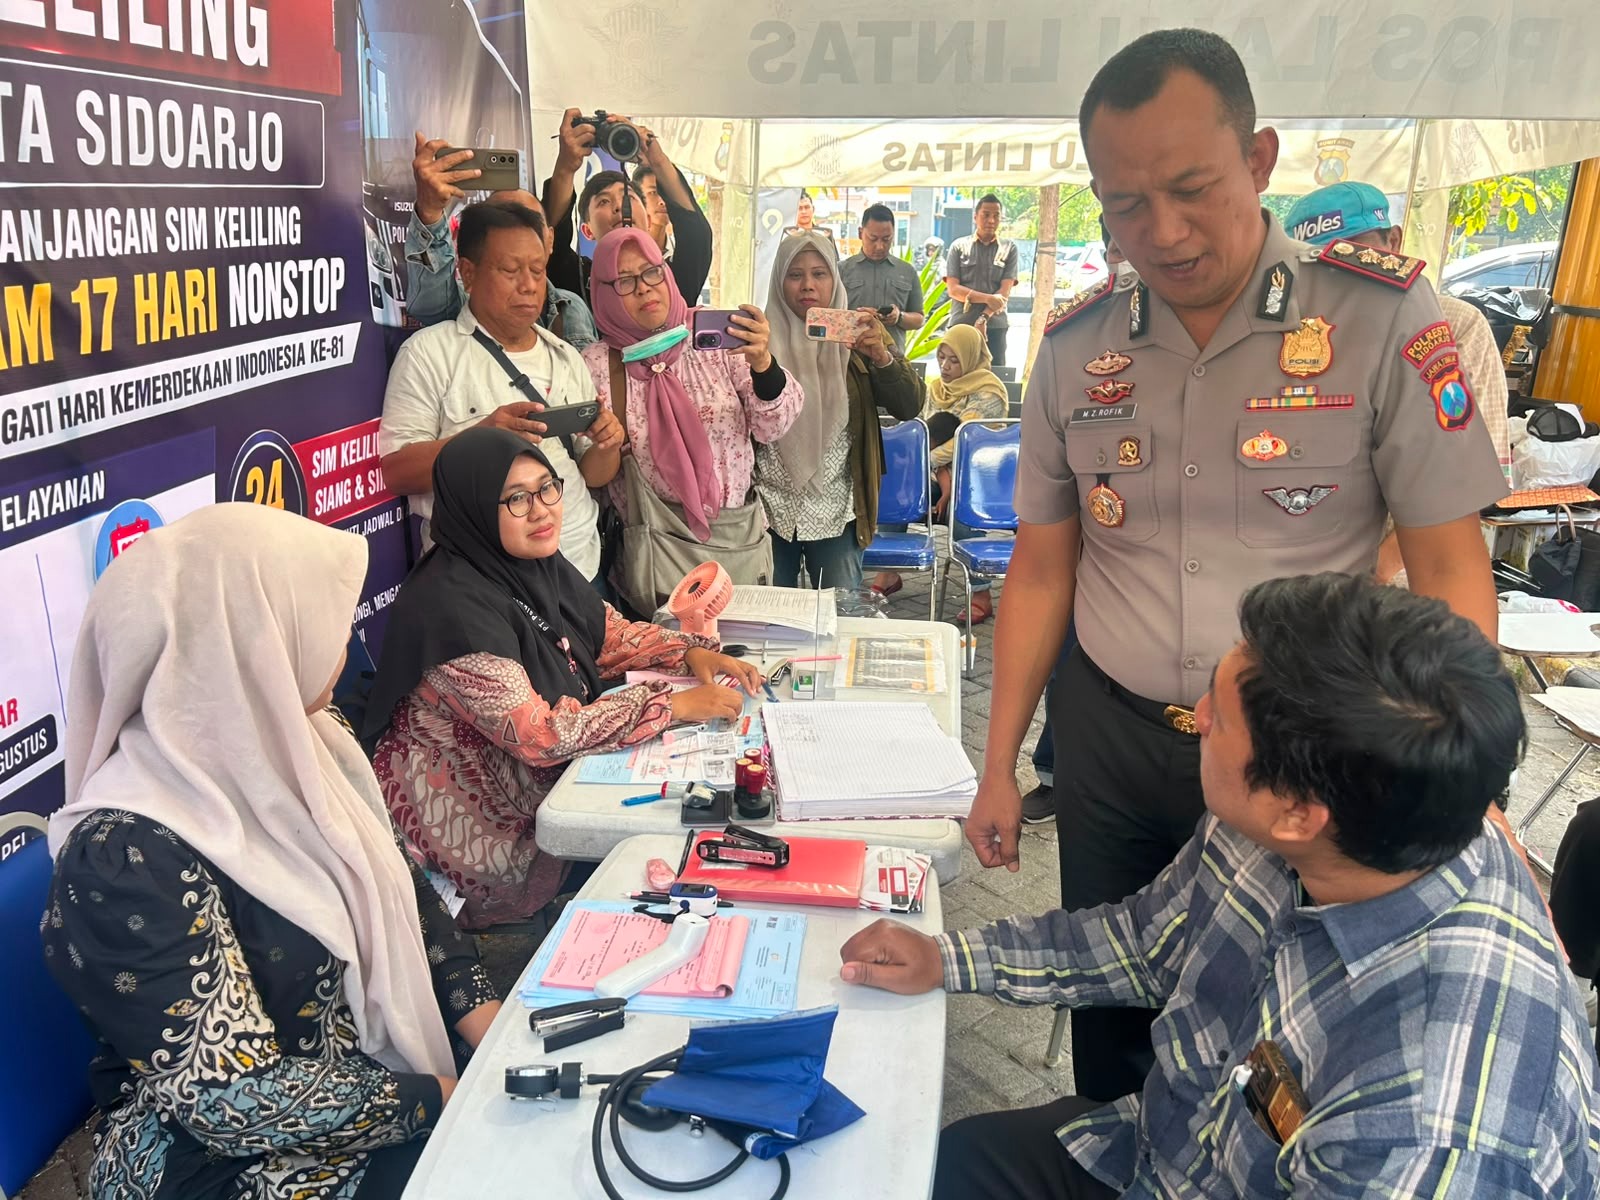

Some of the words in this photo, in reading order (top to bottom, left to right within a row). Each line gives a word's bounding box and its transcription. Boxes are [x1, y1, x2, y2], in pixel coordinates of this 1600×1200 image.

[76, 89, 283, 172] SIDOARJO
[165, 206, 208, 253] SIM
[214, 206, 302, 250] KELILING
[1293, 214, 1341, 241] Woles
[71, 277, 118, 356] 17
[134, 267, 218, 346] HARI
[228, 257, 345, 328] NONSTOP
[1, 400, 54, 445] GATI
[58, 388, 105, 431] HARI
[111, 365, 232, 416] KEMERDEKAAN
[236, 342, 306, 383] INDONESIA
[310, 334, 345, 364] KE-81
[246, 458, 285, 510] 24
[312, 445, 338, 479] SIM
[1, 470, 105, 532] ELAYANAN
[315, 478, 351, 516] SIANG
[354, 474, 364, 500] &
[362, 510, 394, 537] JADWAL
